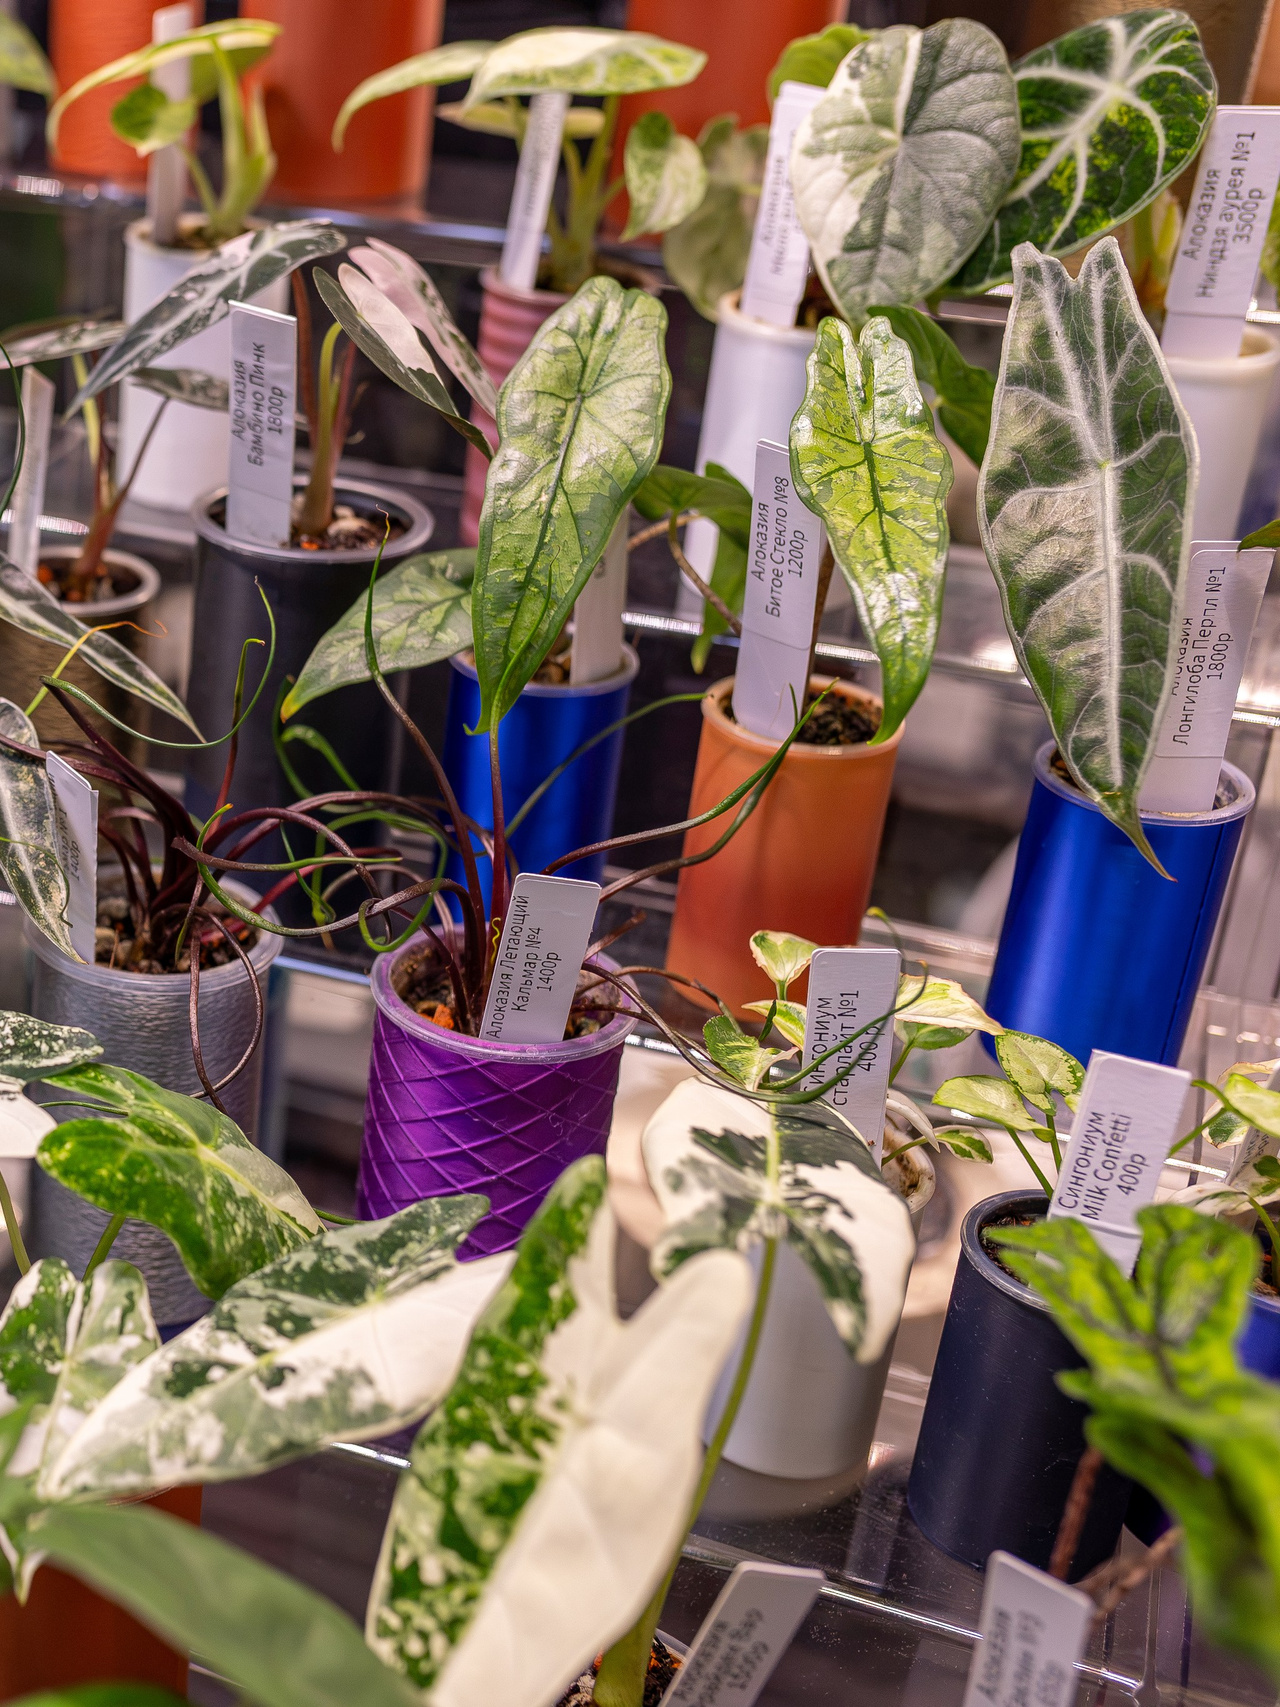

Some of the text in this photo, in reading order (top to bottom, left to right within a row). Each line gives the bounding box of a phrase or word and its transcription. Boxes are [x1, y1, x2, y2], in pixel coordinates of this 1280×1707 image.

[1181, 167, 1221, 260] Алоказия
[1195, 131, 1255, 298] Ниндзя аурея №1
[1232, 188, 1265, 243] 3500р
[230, 360, 246, 441] Алоказия
[248, 342, 265, 467] Бамбино Пинк
[267, 386, 286, 435] 1800р
[751, 502, 769, 582] Алоказия
[765, 476, 789, 617] Битое Стекло №8
[788, 529, 808, 578] 1200р
[1173, 566, 1225, 745] Лонгилоба Перпл №1
[1207, 633, 1233, 680] 1800р
[70, 841, 80, 881] 1400р
[487, 895, 530, 1038] Алоказия Летающий
[512, 927, 543, 1012] Кальмар №4
[537, 952, 561, 991] 1400р
[832, 990, 859, 1106] старлайт №1
[858, 1041, 878, 1072] 400
[1058, 1111, 1106, 1210] Сингониум
[1081, 1112, 1132, 1220] Milk Confetti
[1117, 1153, 1149, 1195] 400р
